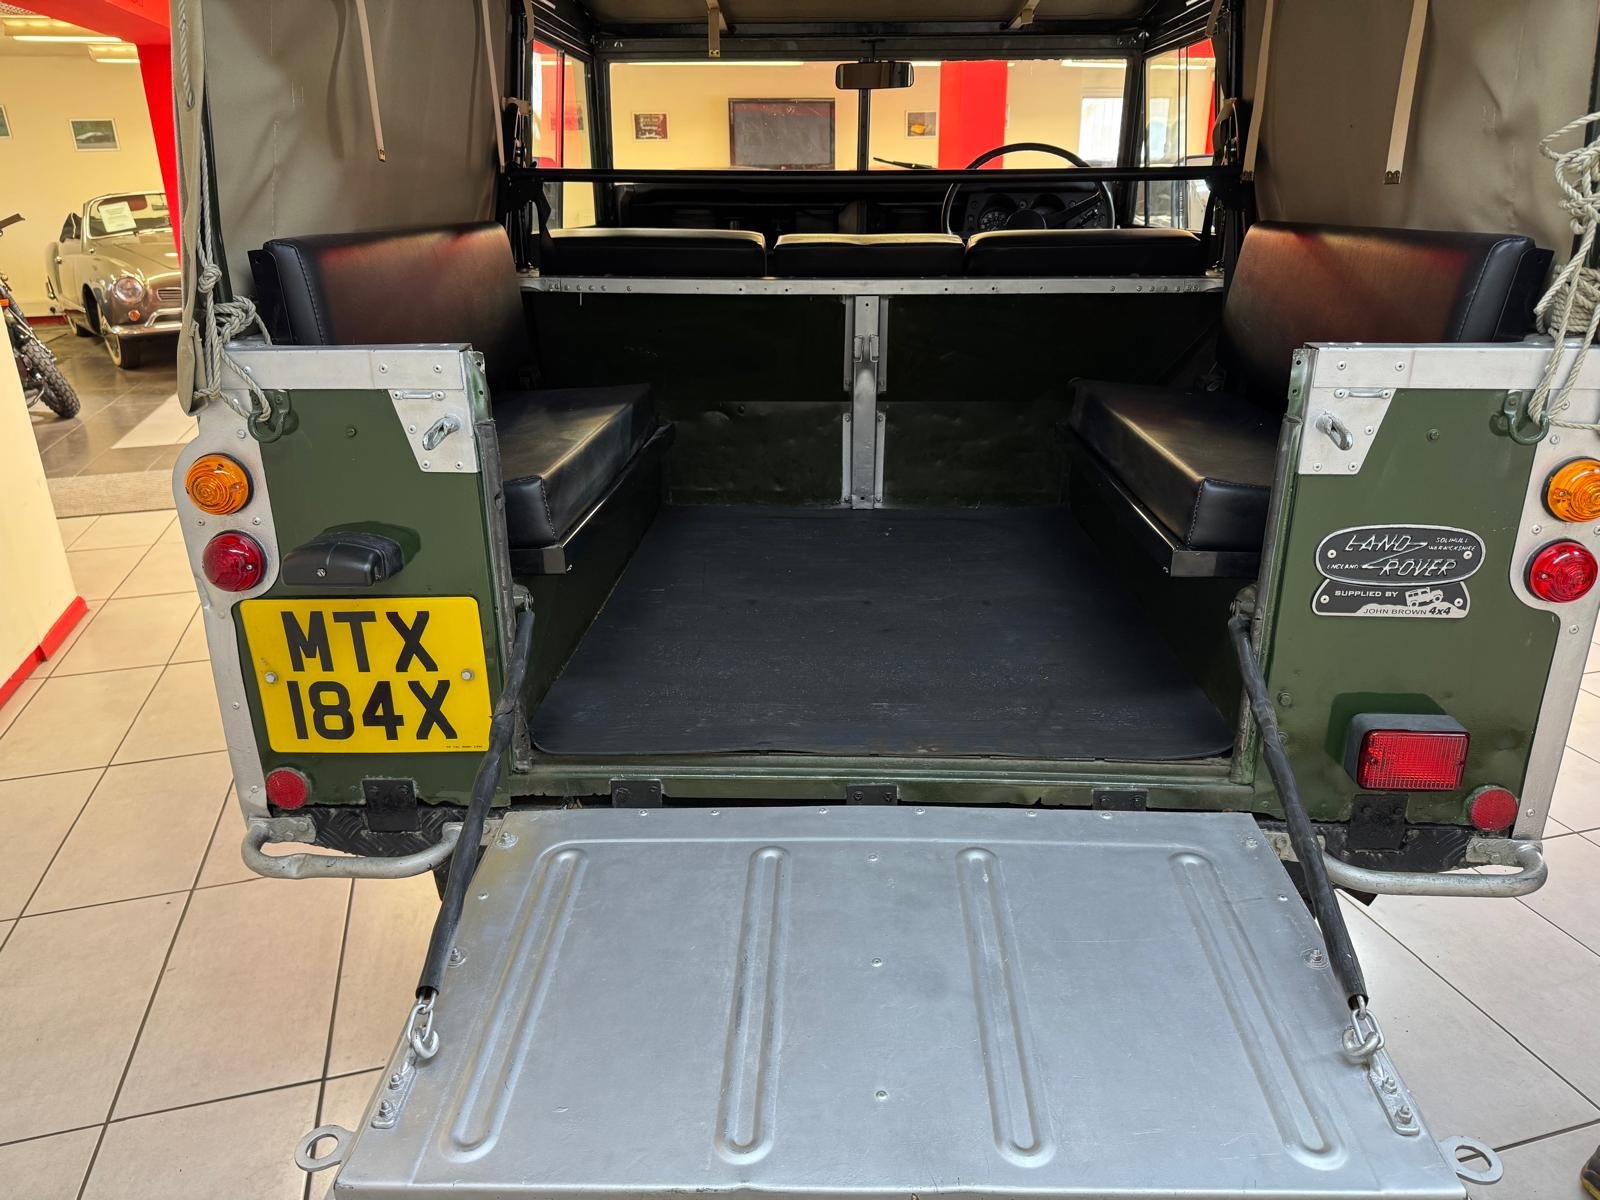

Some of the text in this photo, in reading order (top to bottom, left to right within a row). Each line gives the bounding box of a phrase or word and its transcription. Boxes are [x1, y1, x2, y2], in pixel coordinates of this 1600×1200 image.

[1345, 534, 1412, 551] LAND
[1379, 559, 1457, 576] ROVER
[1334, 590, 1382, 598] SUPPLIED
[1428, 606, 1452, 616] 4x4
[280, 610, 439, 673] MTX
[286, 679, 459, 741] 184X
